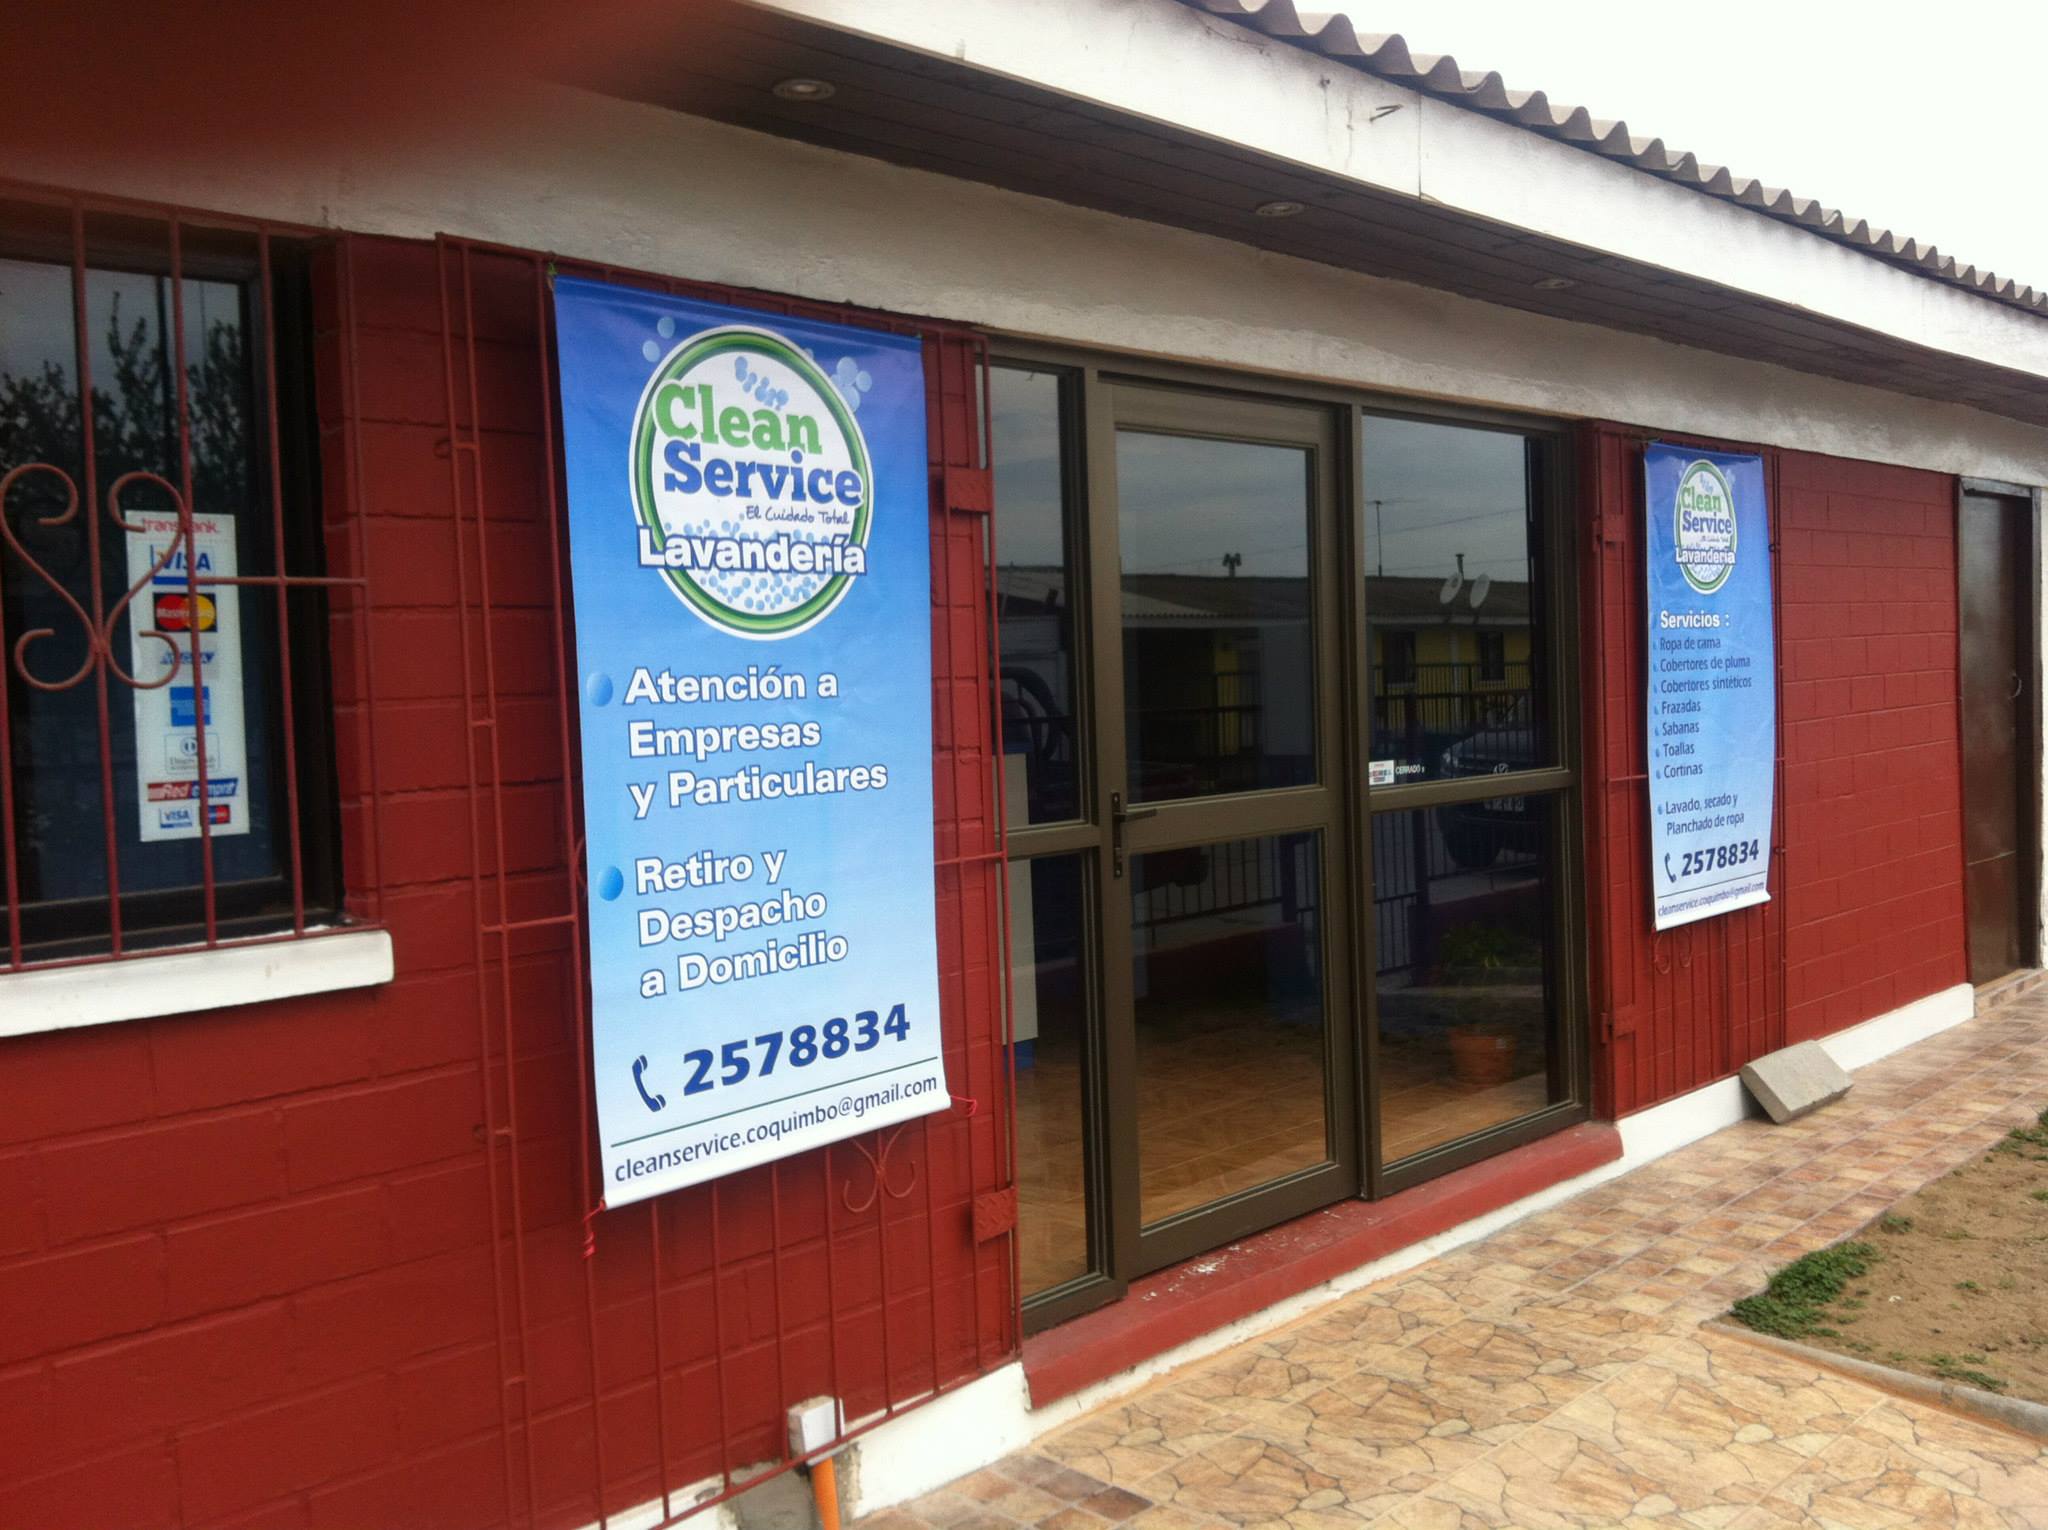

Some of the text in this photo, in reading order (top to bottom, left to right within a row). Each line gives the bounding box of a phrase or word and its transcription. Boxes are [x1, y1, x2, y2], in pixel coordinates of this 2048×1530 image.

[655, 383, 822, 454] Clean
[664, 440, 862, 506] Service
[1681, 486, 1722, 512] Clean
[746, 505, 850, 524] El Cuidado Total
[1682, 510, 1732, 534] Service
[156, 552, 211, 571] VIA
[637, 525, 867, 575] Lavandería
[1660, 610, 1720, 629] Servicios
[1660, 636, 1721, 654] Ropa de cama
[1660, 656, 1751, 672] Cobertores de pluma
[623, 666, 838, 705] Atención a
[1661, 676, 1752, 693] Cobertores sintéticos
[1661, 699, 1701, 715] Frazadas
[628, 720, 821, 761] Empresas
[1662, 721, 1700, 736] Sabanas
[1663, 743, 1695, 757] Toallas
[1664, 763, 1703, 778] Cortinas
[627, 761, 888, 820] y Particulares
[1665, 793, 1738, 815] Lavado, secado y
[1667, 812, 1745, 836] Planchado de ropa
[1681, 839, 1759, 877] 2578834
[635, 850, 786, 895] Retiro y
[638, 889, 826, 946] Despacho
[640, 931, 848, 998] a Domicilio
[683, 1003, 910, 1096] 2578834
[615, 1075, 937, 1181] cleanservice.coquimbo@gmail.com
